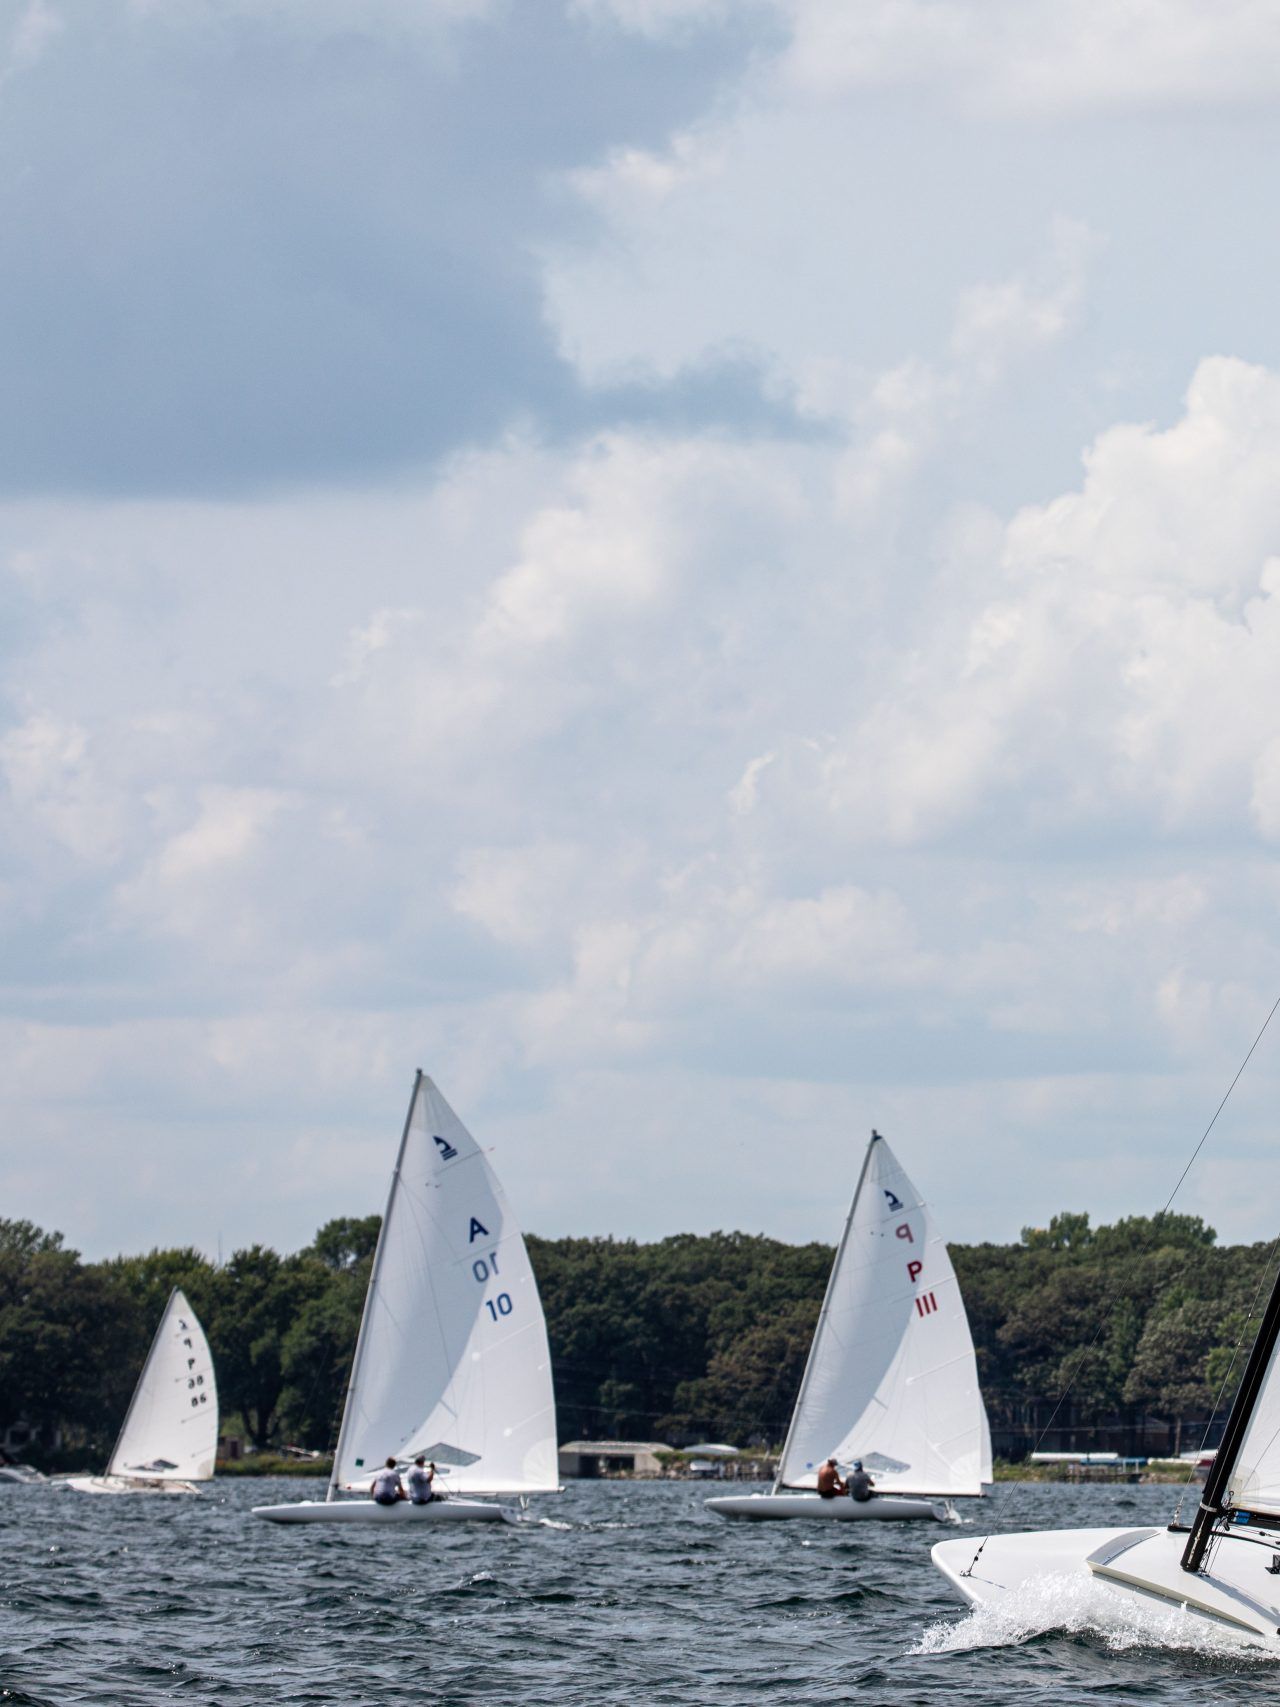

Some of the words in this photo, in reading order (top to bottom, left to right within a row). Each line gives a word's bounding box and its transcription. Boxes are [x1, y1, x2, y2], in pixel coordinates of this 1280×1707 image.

[469, 1217, 489, 1243] A
[906, 1260, 923, 1283] P
[485, 1292, 513, 1322] 10
